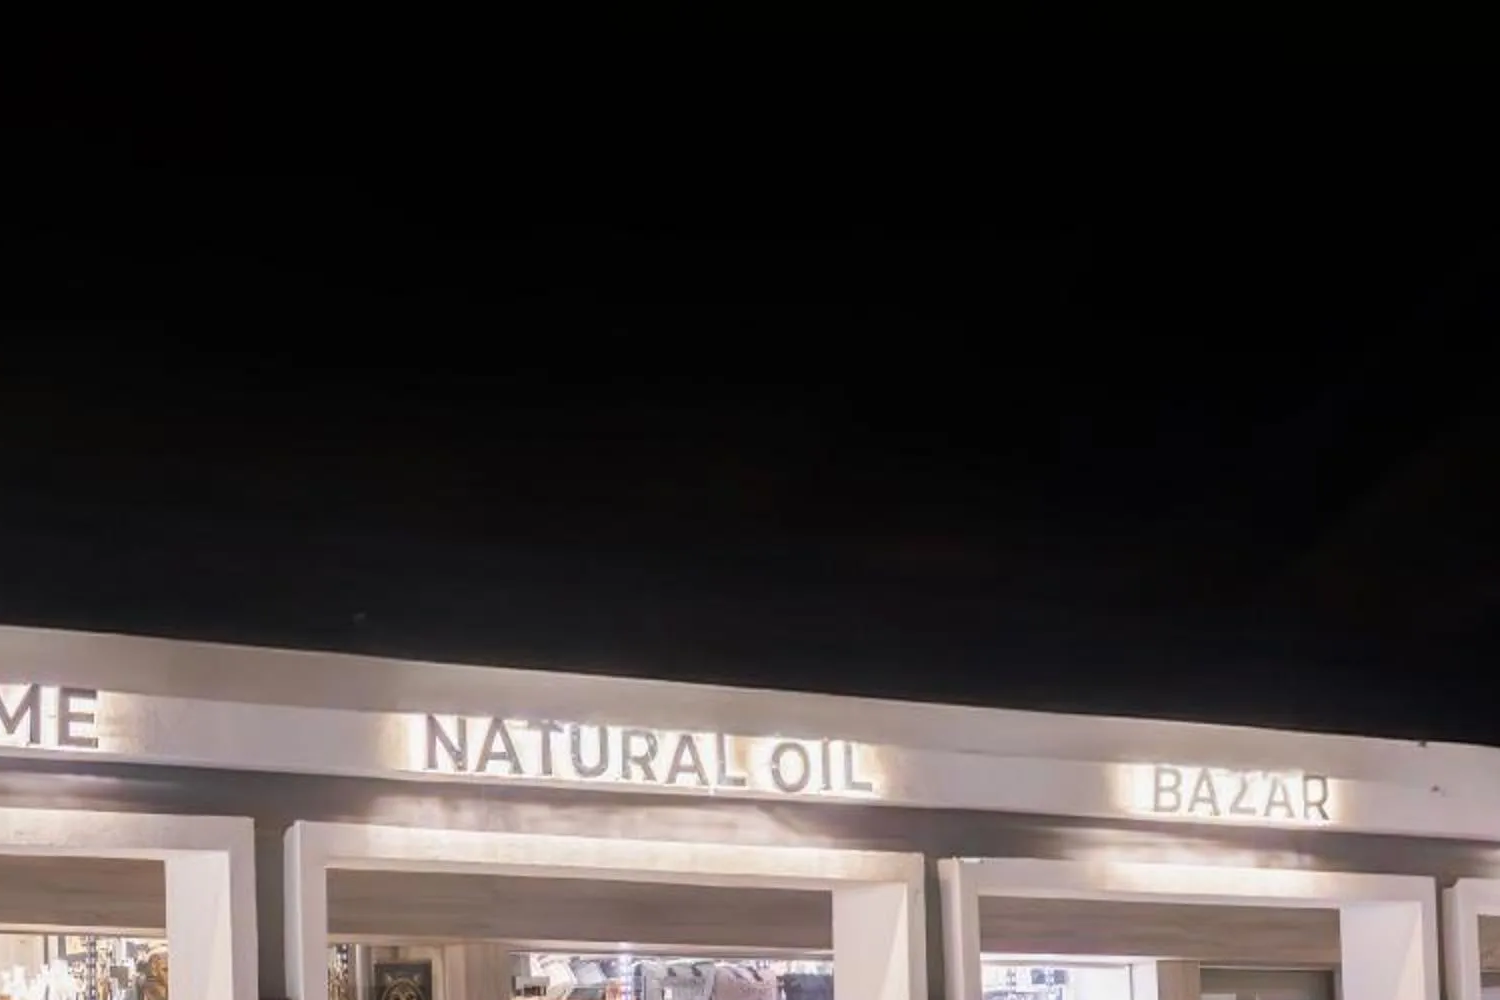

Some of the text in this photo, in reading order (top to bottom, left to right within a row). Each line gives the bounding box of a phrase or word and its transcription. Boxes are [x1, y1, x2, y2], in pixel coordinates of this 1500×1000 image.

[425, 715, 873, 793] NATURAL OIL
[1152, 766, 1330, 821] BAZAR
